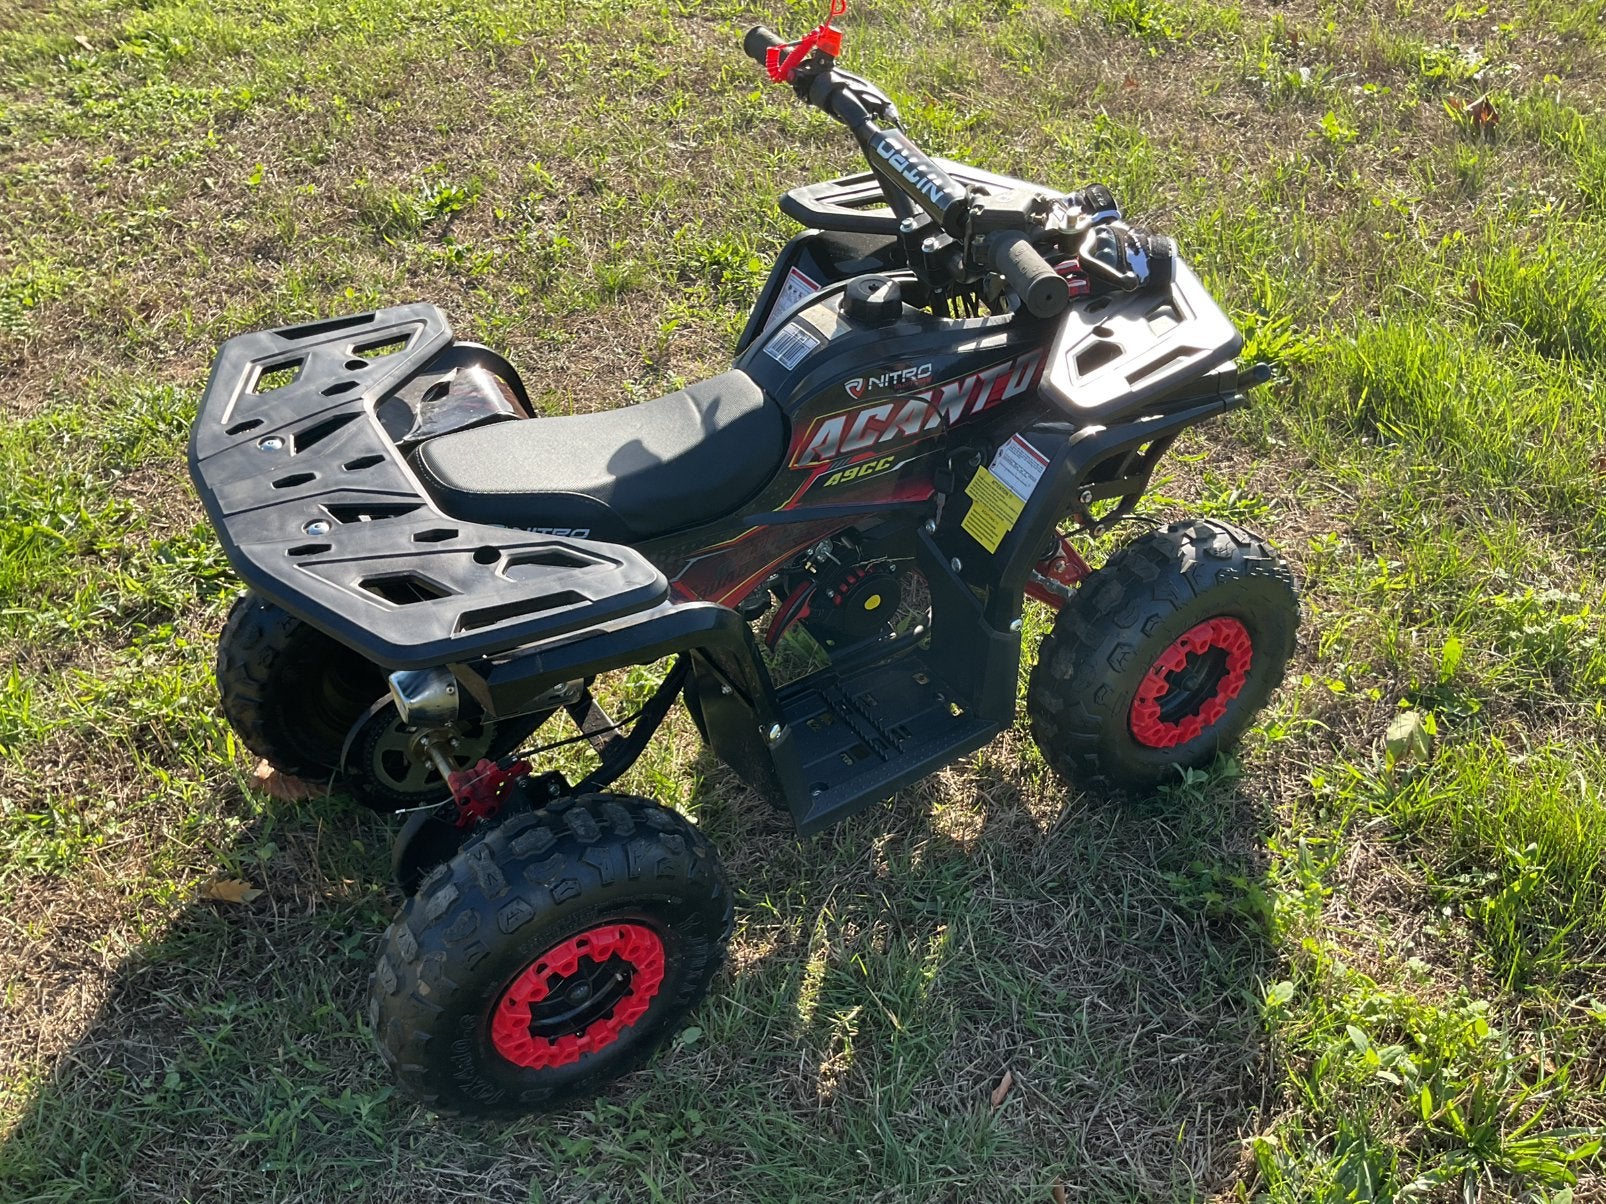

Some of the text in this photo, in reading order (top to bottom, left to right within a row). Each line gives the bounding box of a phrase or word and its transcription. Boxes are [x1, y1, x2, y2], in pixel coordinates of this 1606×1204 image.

[877, 137, 953, 203] NITRO
[868, 363, 932, 390] NITRO
[799, 349, 1042, 465] ACANTO
[823, 455, 895, 488] 49CC
